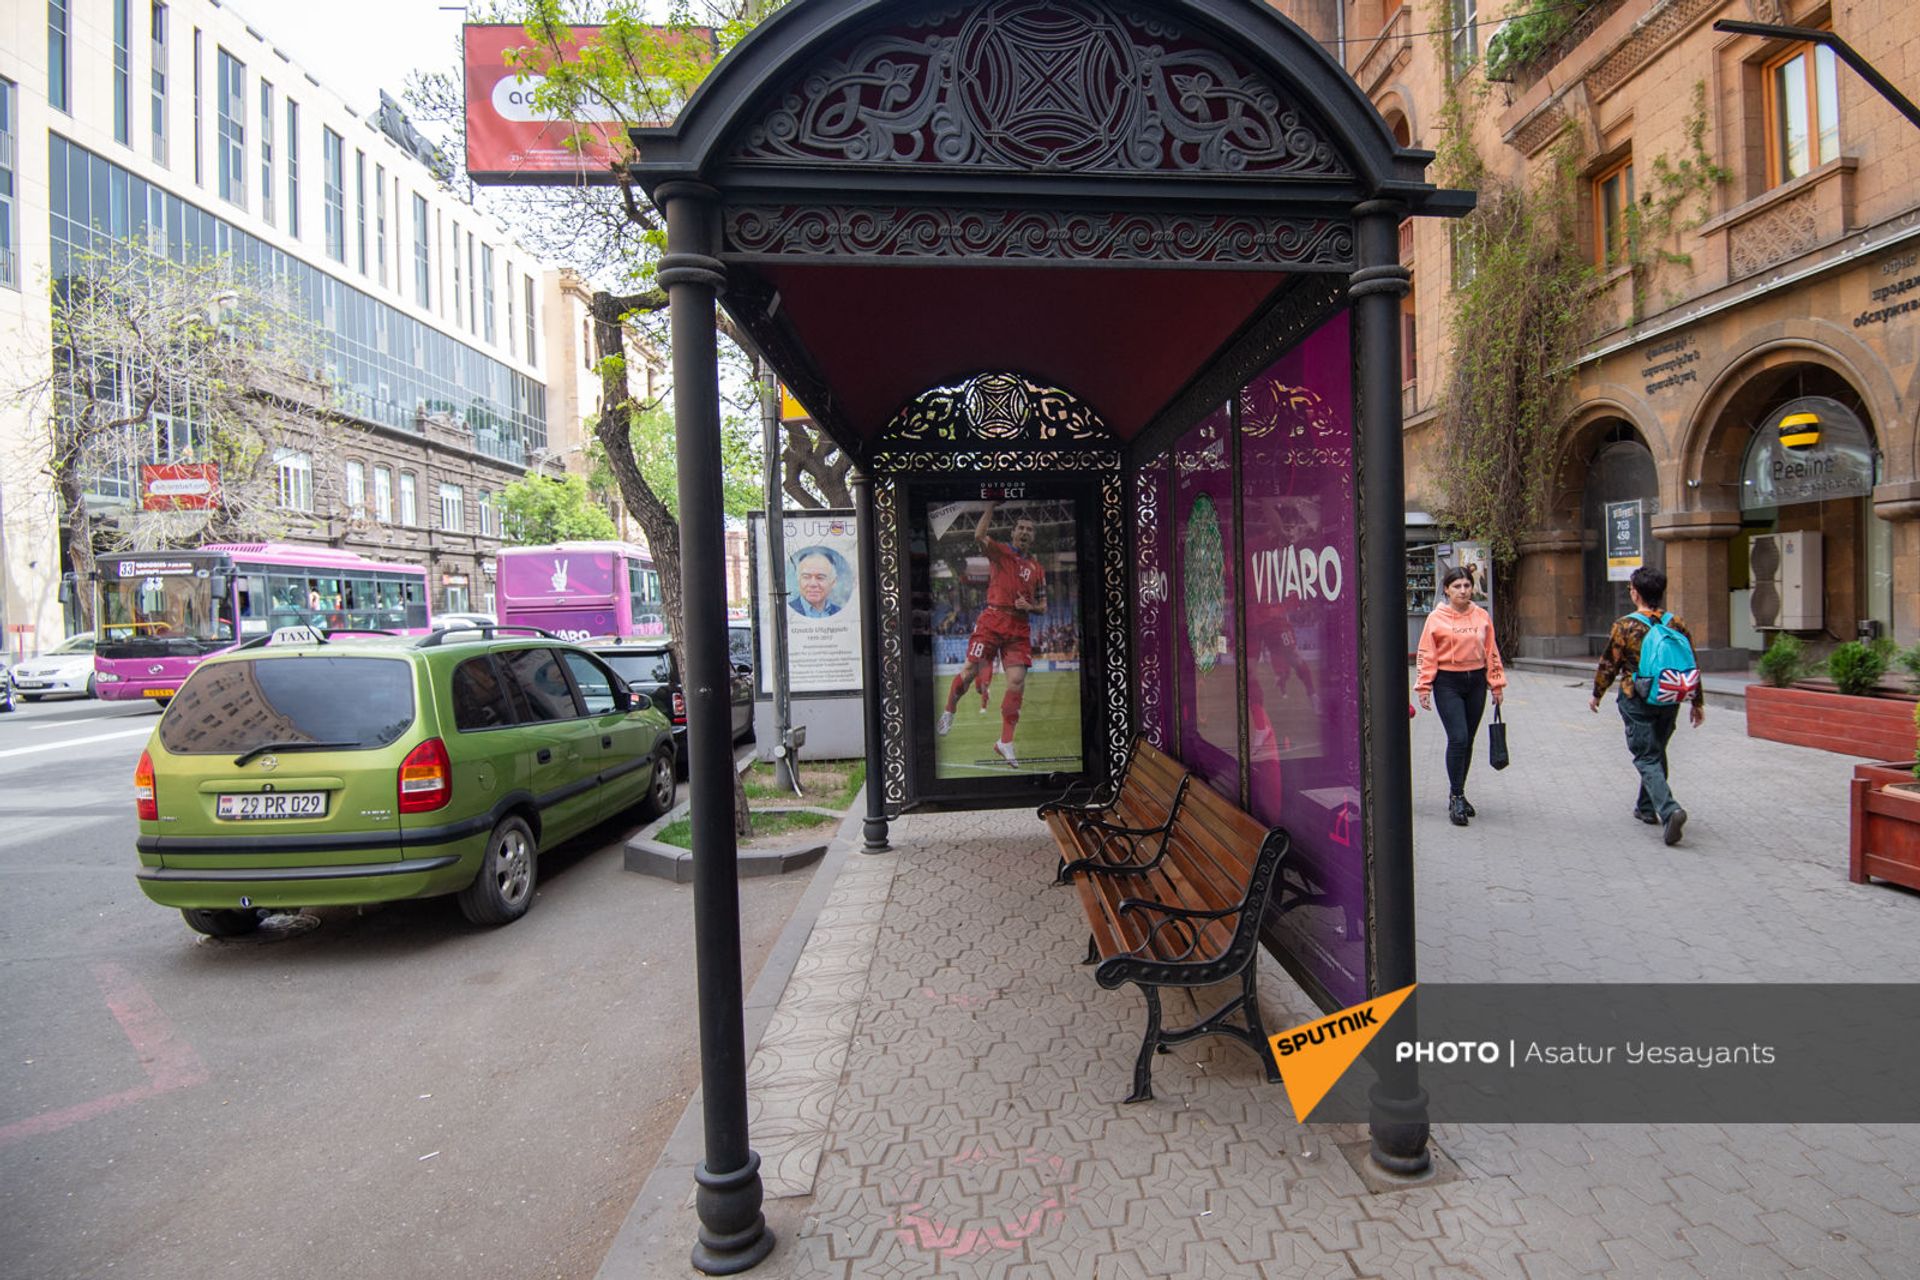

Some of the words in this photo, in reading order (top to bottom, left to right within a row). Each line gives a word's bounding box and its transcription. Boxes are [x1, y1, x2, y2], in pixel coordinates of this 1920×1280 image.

[121, 562, 134, 576] 33
[1251, 544, 1343, 604] VIVARO
[279, 631, 311, 642] TAXI
[969, 641, 985, 658] 18
[240, 797, 260, 814] 29
[264, 796, 287, 812] PR
[290, 795, 320, 812] 029
